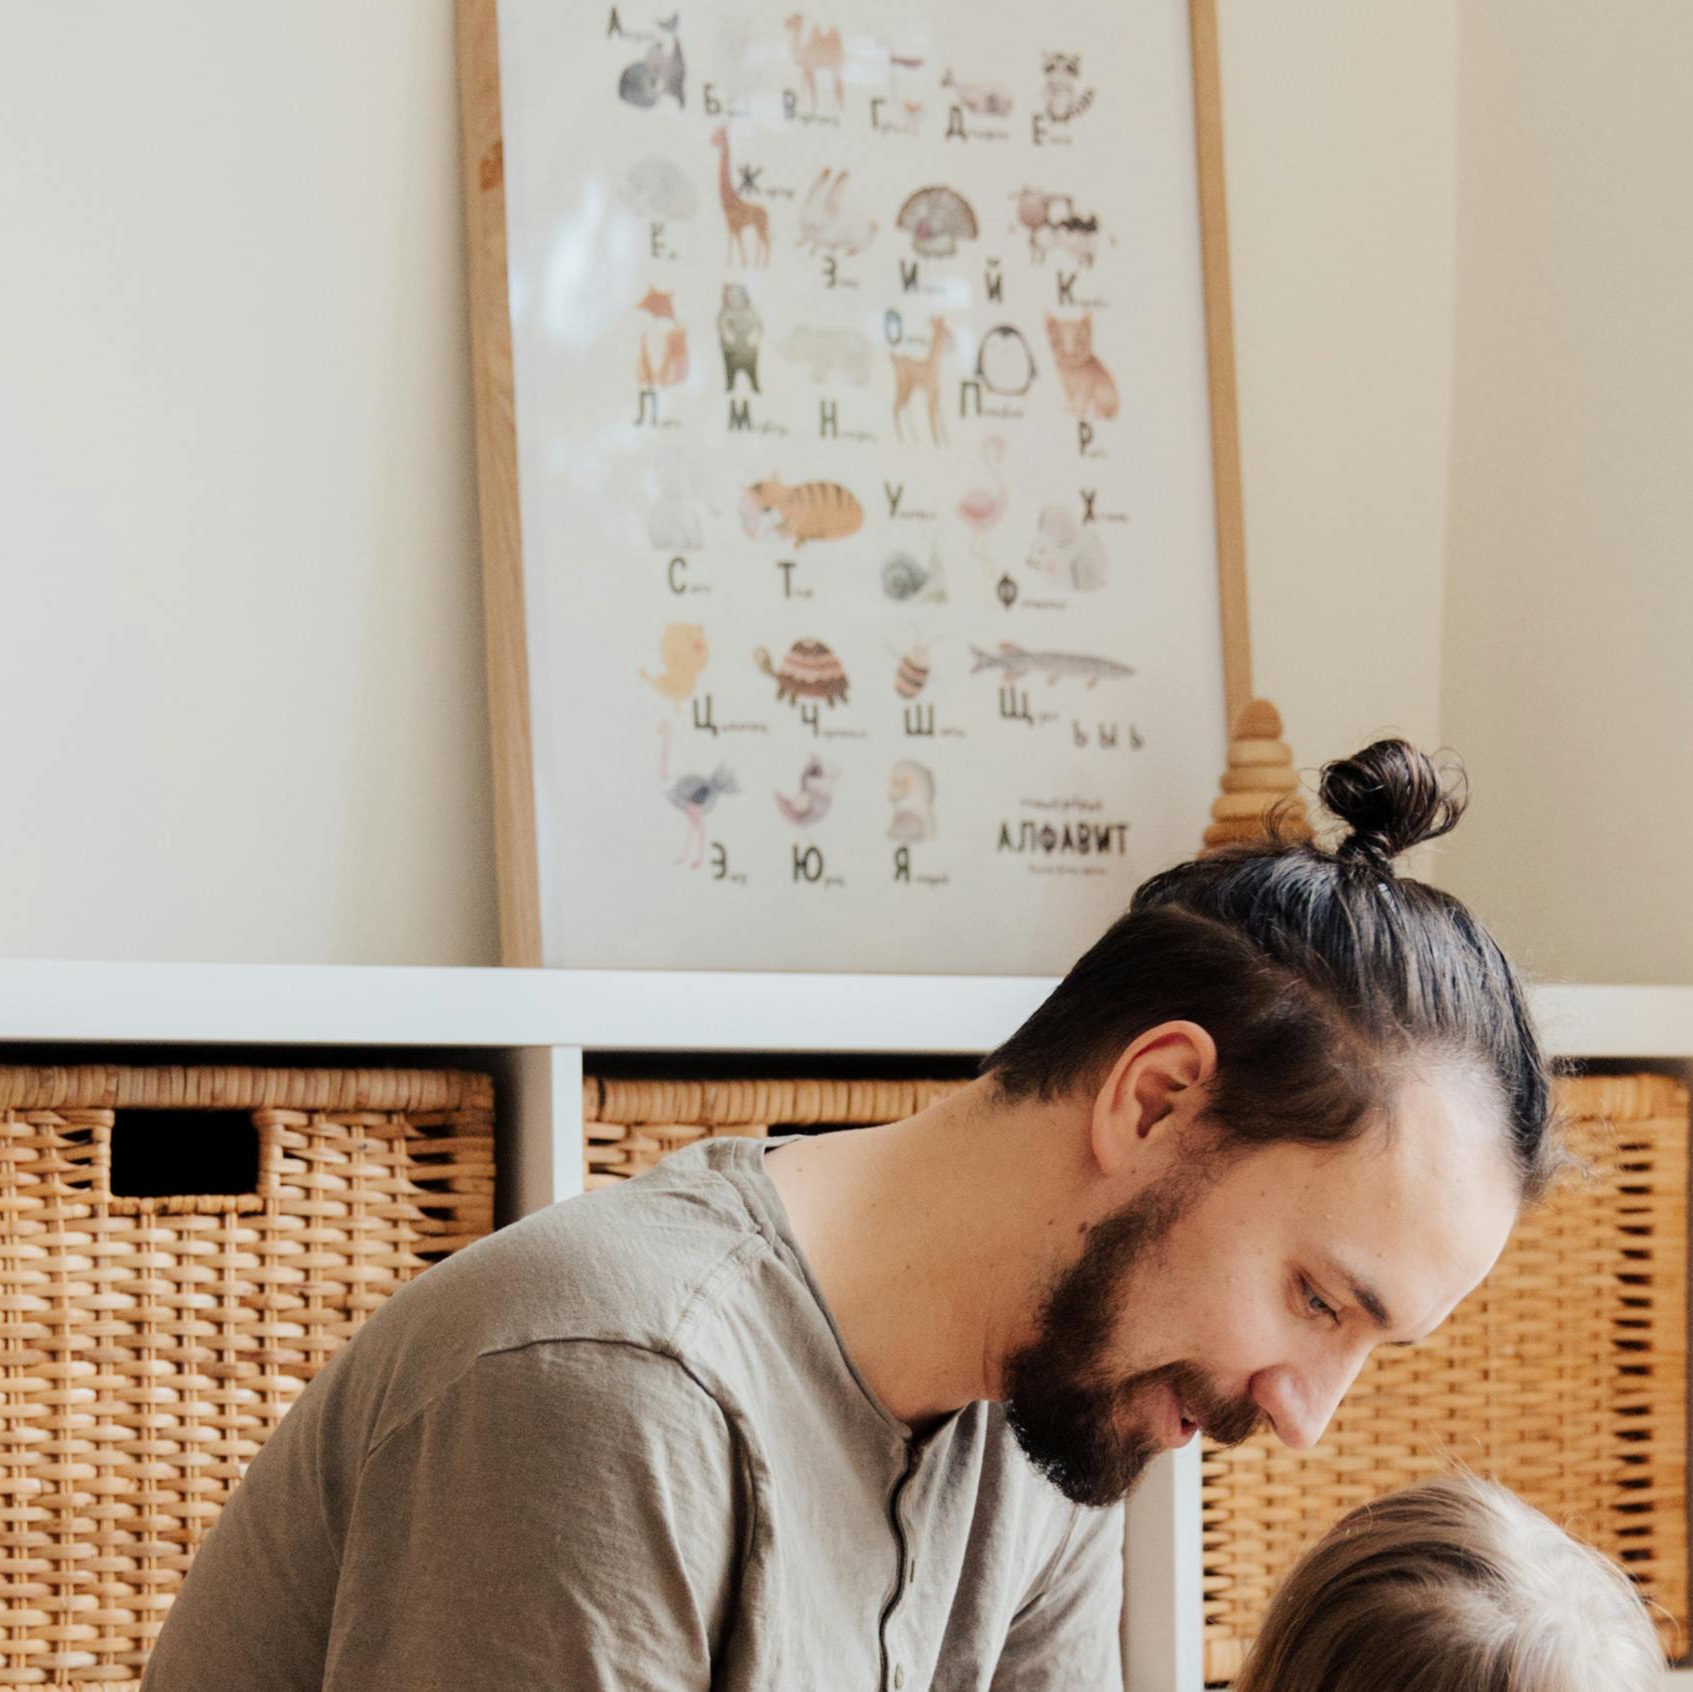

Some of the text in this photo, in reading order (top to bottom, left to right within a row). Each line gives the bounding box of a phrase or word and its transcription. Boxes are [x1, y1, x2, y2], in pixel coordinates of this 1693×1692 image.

[985, 258, 1002, 303] Й
[728, 399, 750, 431] М
[820, 399, 837, 438] Н
[904, 703, 934, 736] Ш
[999, 686, 1033, 726] Щ
[997, 820, 1129, 856] АЛФАВИТ
[792, 844, 823, 883] Ю
[895, 845, 910, 882] Я
